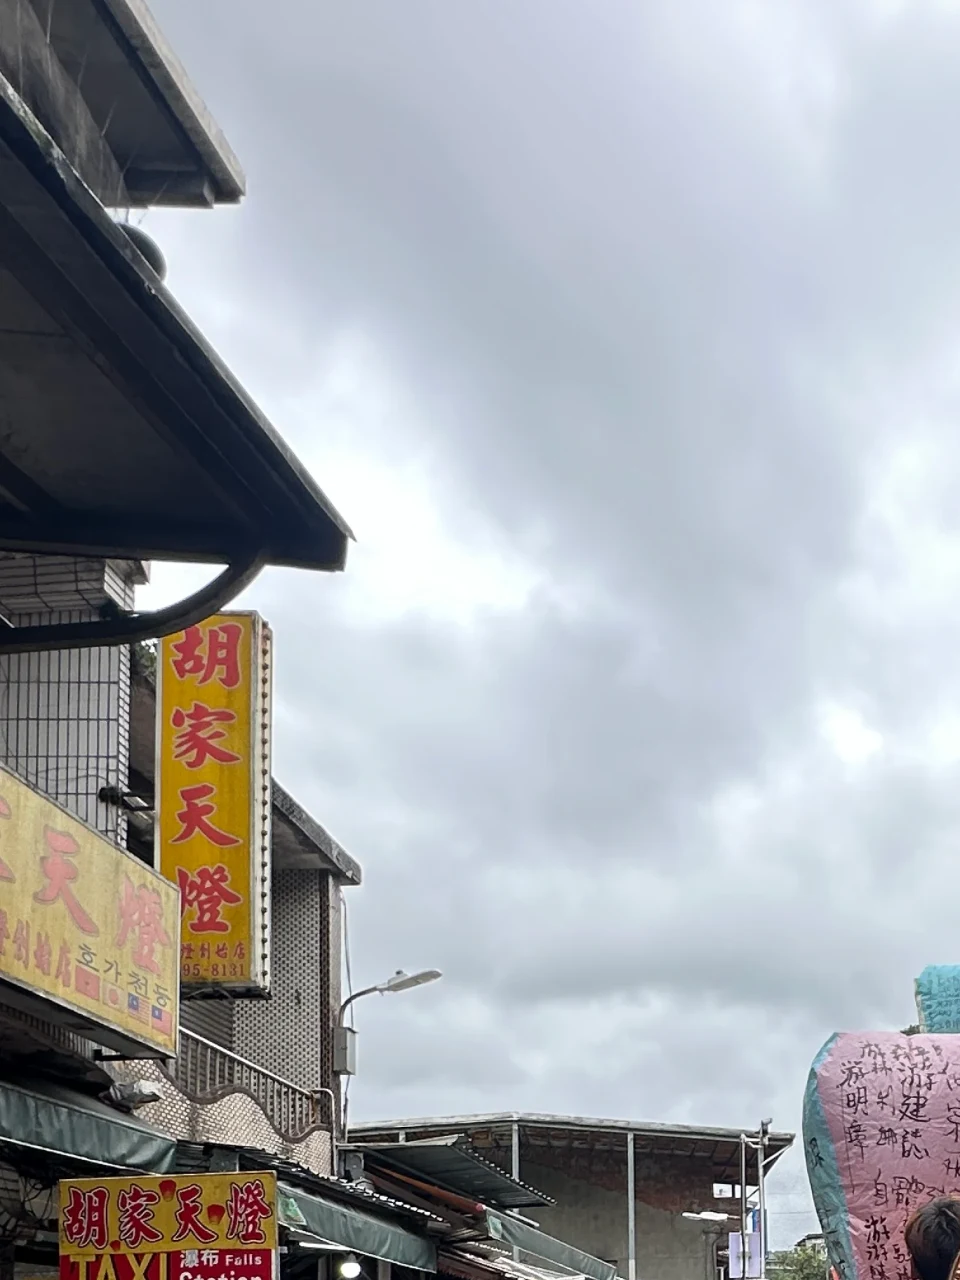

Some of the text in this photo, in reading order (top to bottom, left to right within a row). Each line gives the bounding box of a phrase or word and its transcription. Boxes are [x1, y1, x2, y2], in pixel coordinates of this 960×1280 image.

[170, 621, 243, 934] 胡家天燈
[0, 795, 171, 978] 天燈
[63, 1178, 273, 1250] 胡家天燈
[179, 1249, 219, 1268] 瀑布
[225, 1253, 262, 1267] Falls
